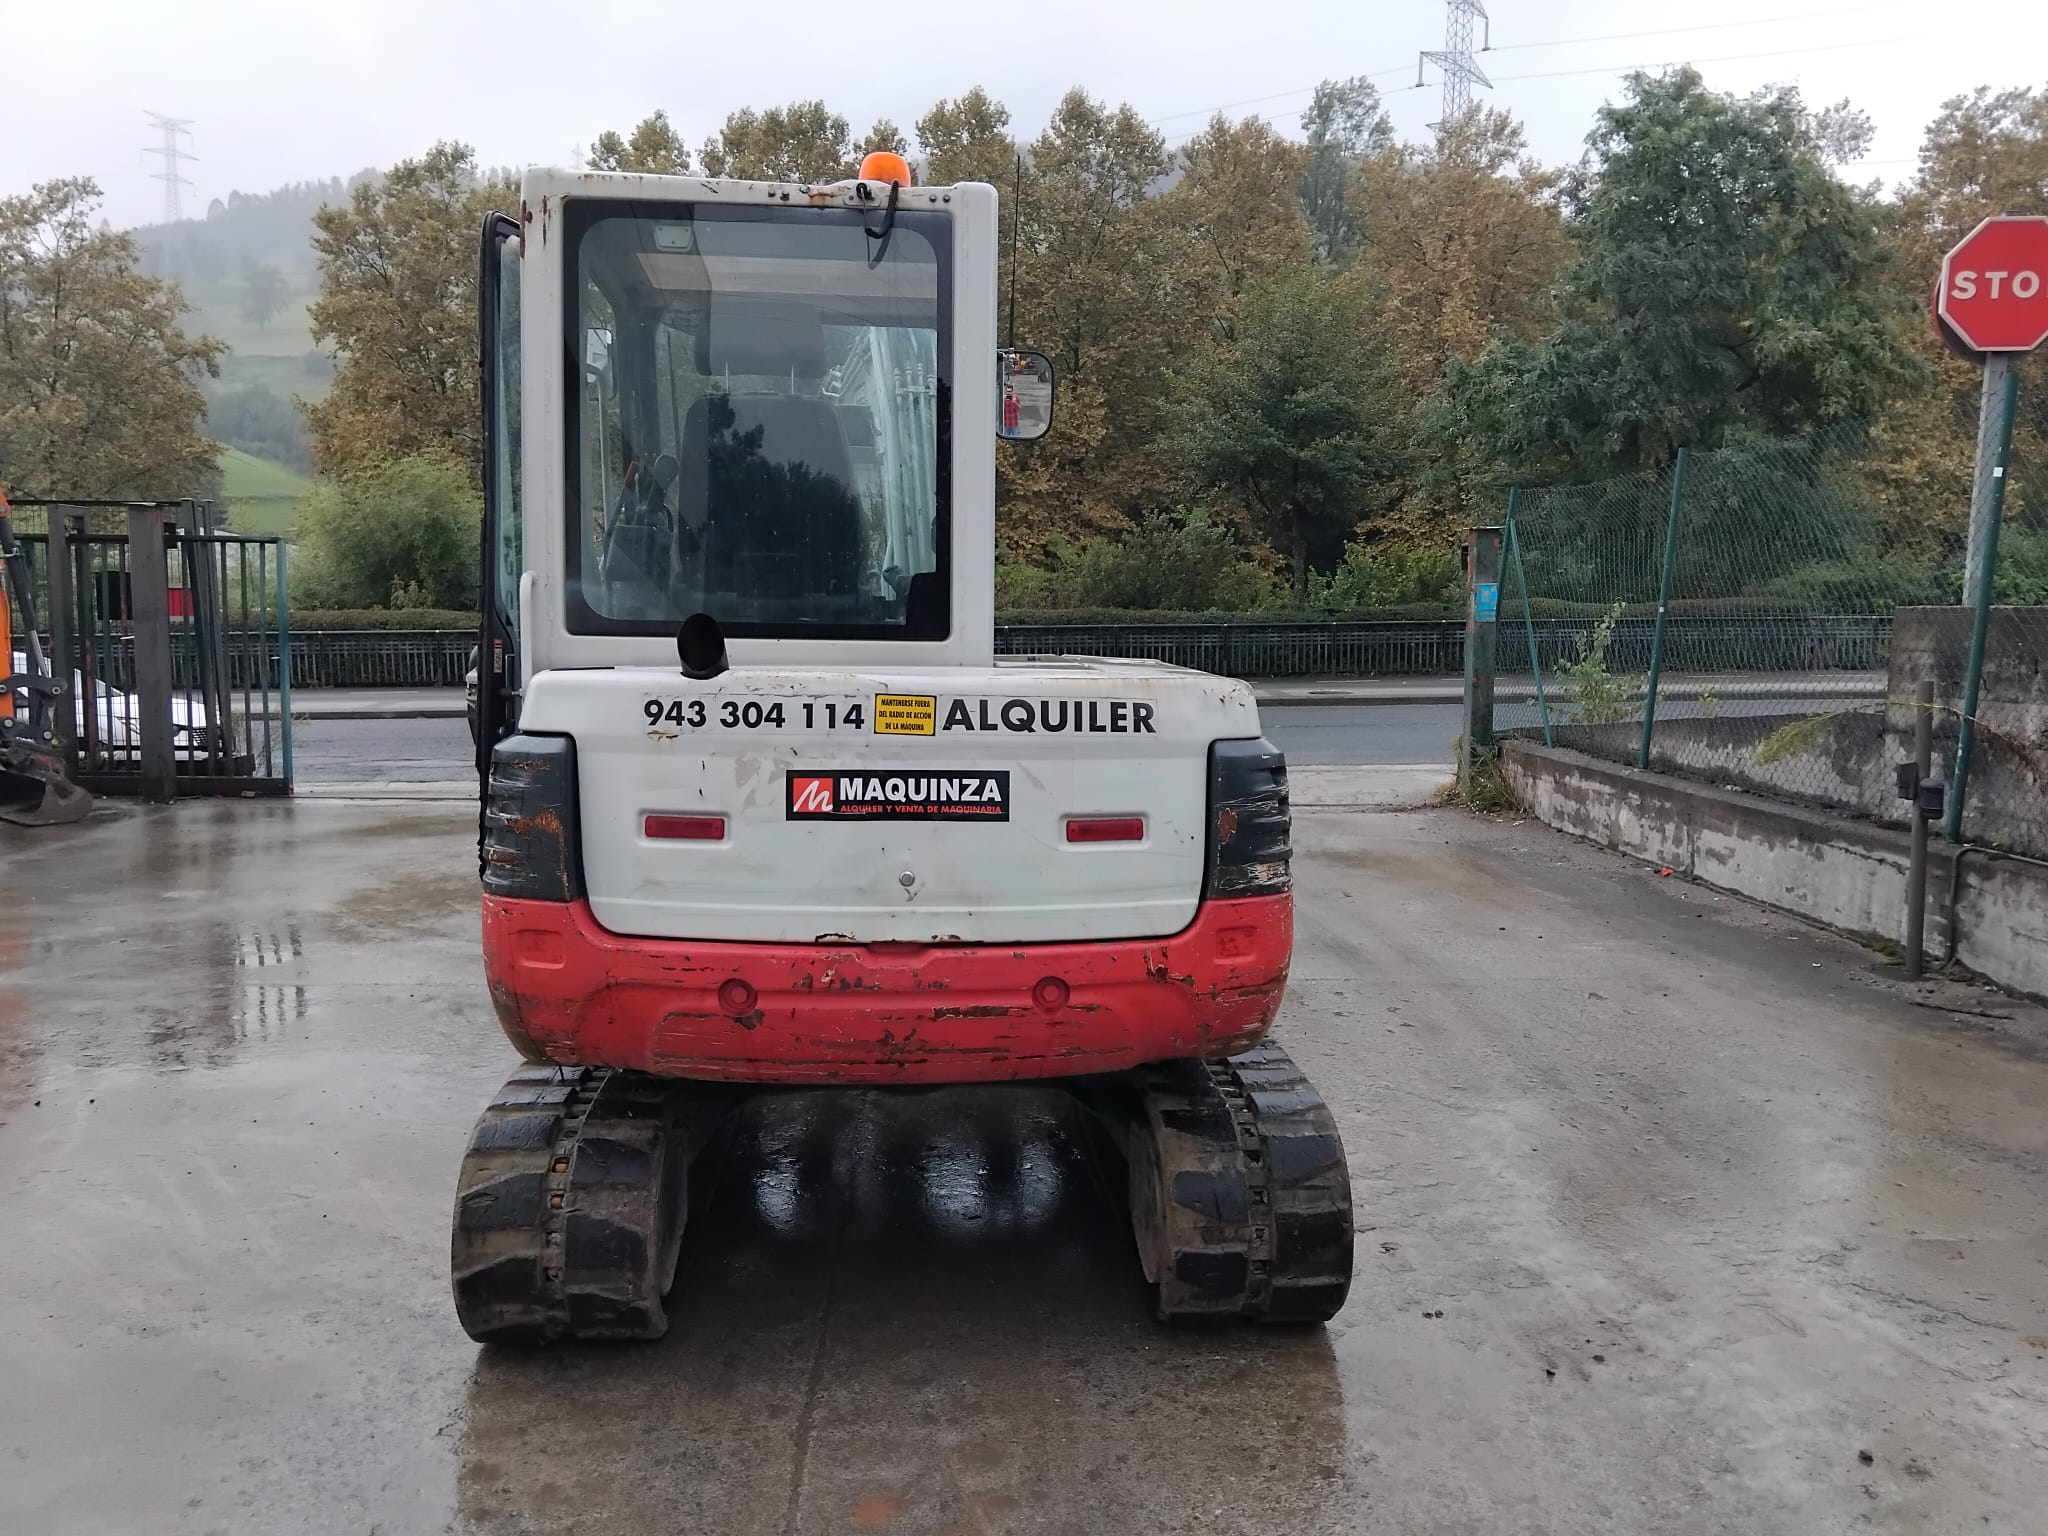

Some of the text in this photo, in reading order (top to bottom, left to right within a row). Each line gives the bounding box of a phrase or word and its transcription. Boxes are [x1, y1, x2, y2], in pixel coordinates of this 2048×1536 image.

[1951, 270, 2048, 300] STO
[644, 699, 865, 730] 943 304 114
[881, 698, 913, 707] MANTENERSE
[889, 710, 904, 718] RADIO
[942, 698, 1157, 734] ALQUILER
[839, 777, 1002, 803] MAQUINZA
[840, 804, 1002, 815] ALQUILER Y VENTA DE MAQUINARIA
